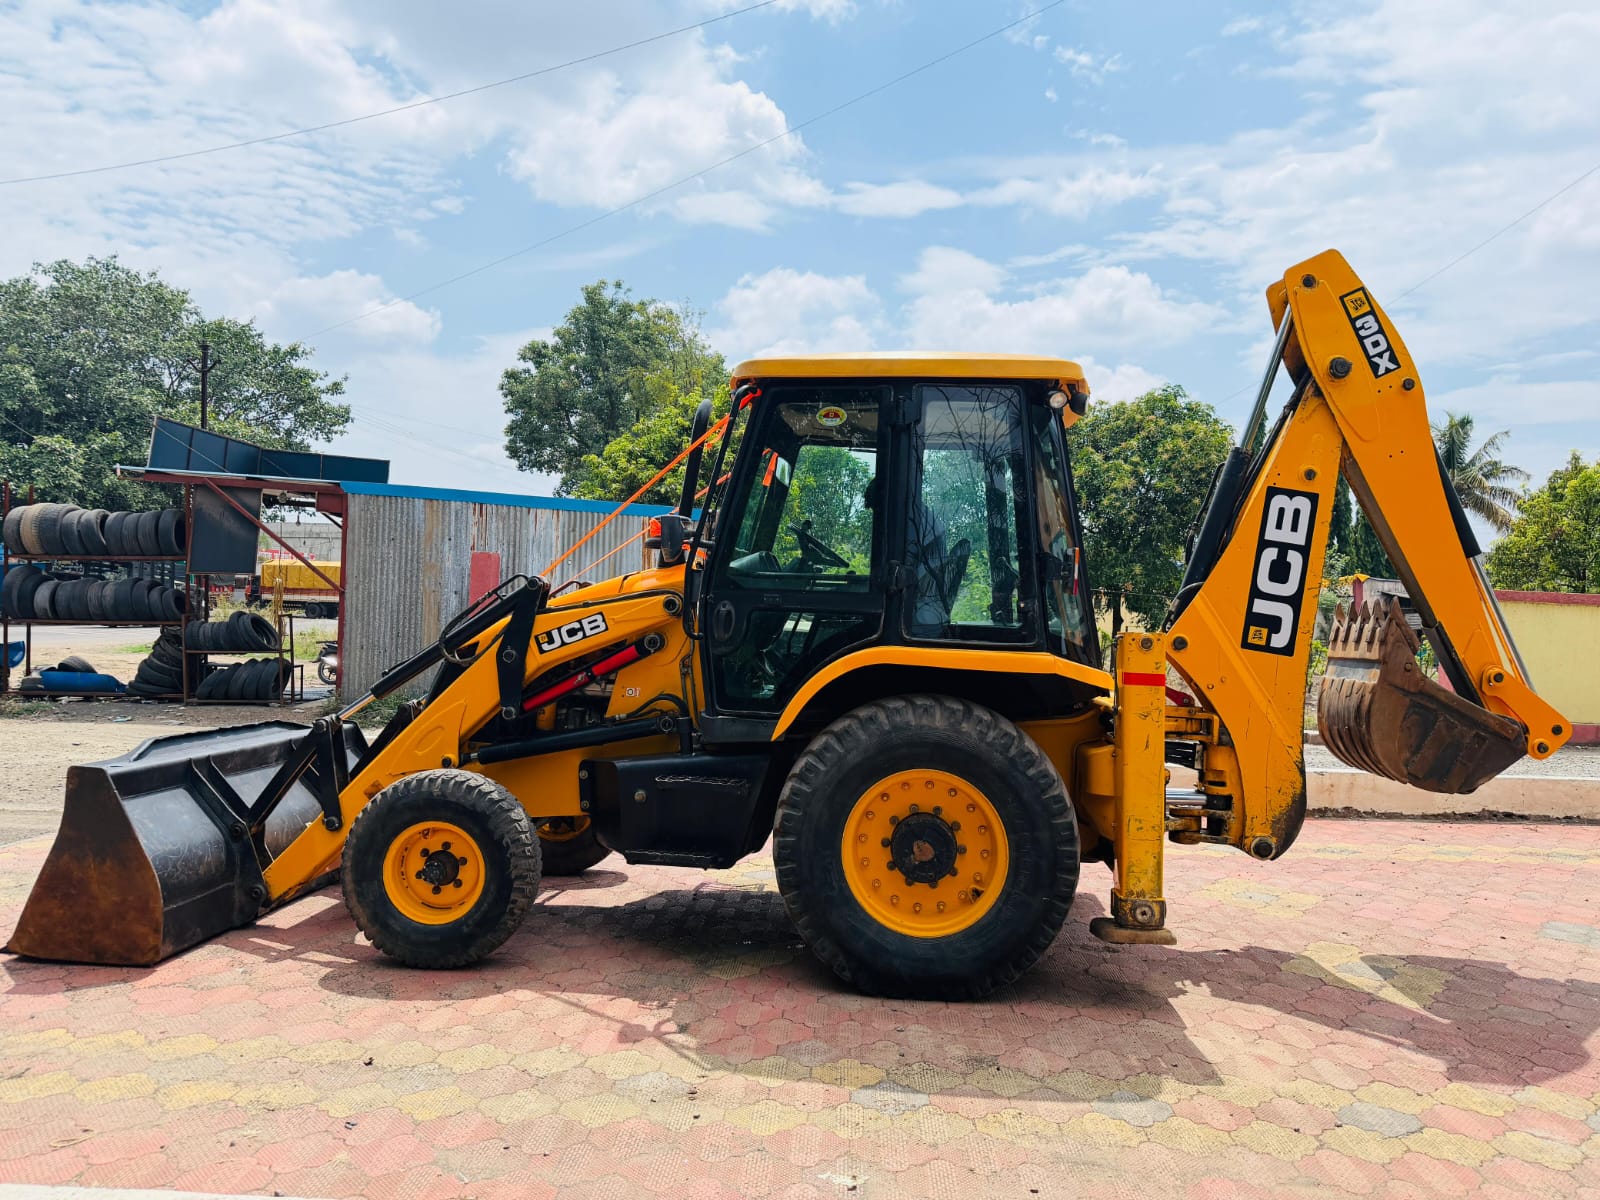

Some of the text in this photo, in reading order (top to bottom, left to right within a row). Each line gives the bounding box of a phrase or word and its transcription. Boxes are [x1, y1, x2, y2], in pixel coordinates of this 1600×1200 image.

[1355, 314, 1399, 376] 3DX
[1252, 494, 1312, 649] JCB
[541, 614, 607, 651] JCB
